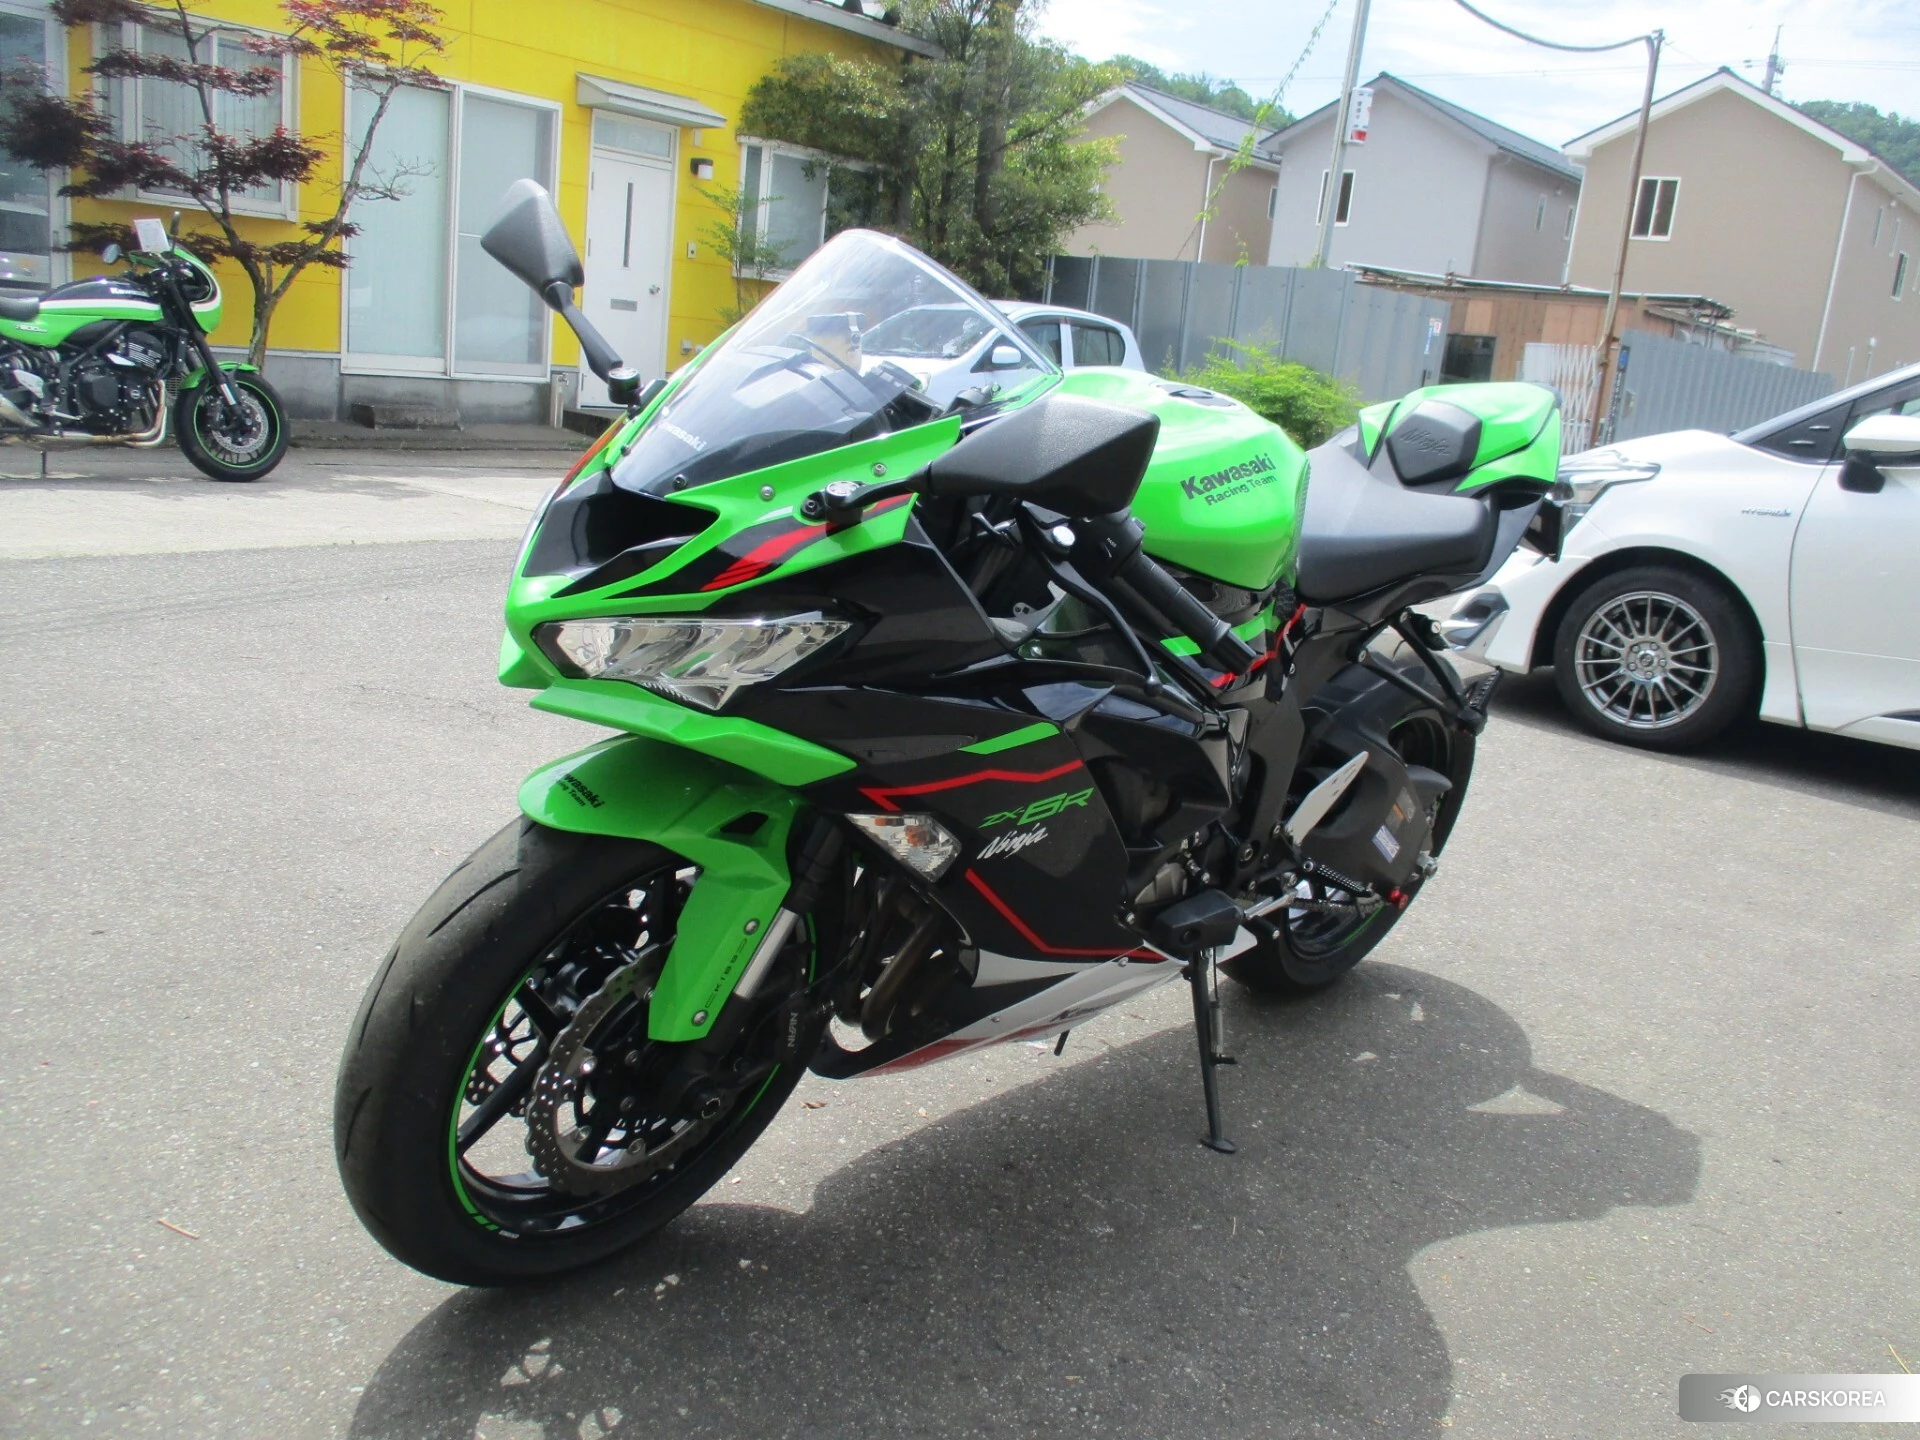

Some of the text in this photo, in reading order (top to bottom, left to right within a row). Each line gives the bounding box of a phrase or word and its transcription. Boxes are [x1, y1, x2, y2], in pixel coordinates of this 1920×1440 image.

[1180, 453, 1276, 500] Kawasaki
[1204, 475, 1277, 506] Racing Team
[564, 774, 605, 808] wasaki
[976, 822, 1049, 860] Ninja
